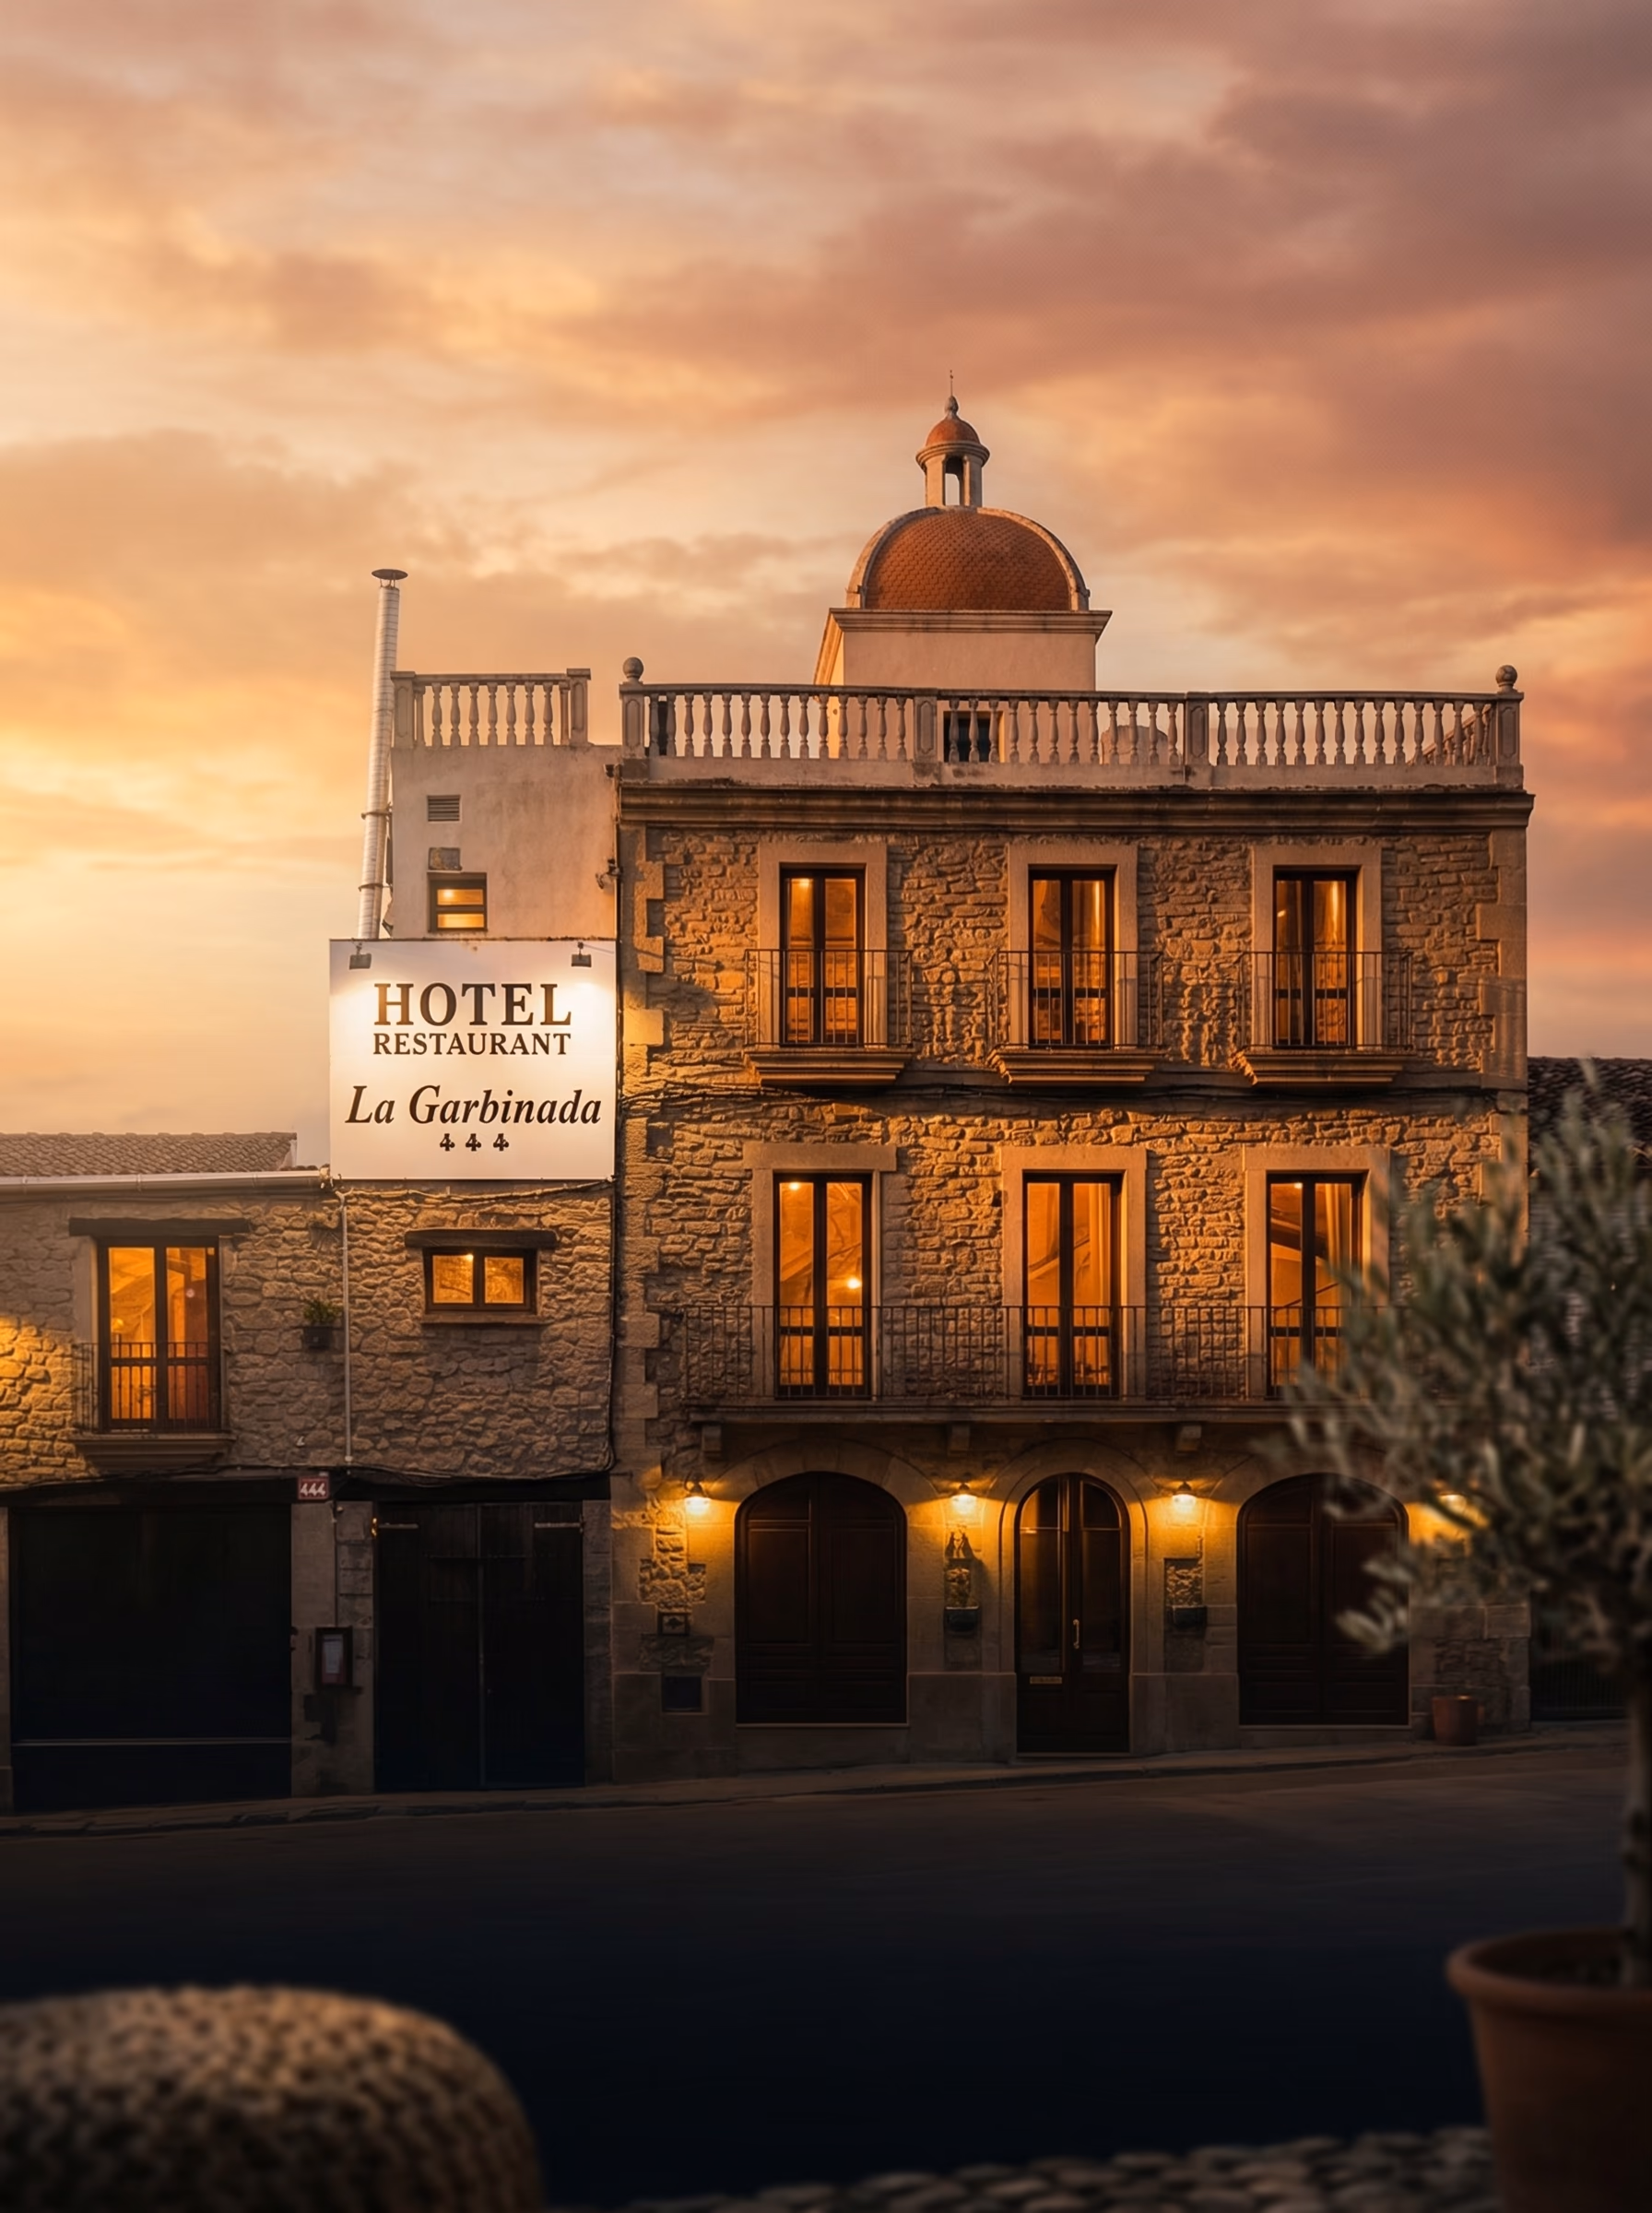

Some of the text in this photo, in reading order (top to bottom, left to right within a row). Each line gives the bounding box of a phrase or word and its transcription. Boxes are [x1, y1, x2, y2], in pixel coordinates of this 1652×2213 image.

[373, 982, 572, 1026] HOTEL
[372, 1032, 572, 1056] RESTAURANT
[344, 1084, 602, 1125] La Garbinada
